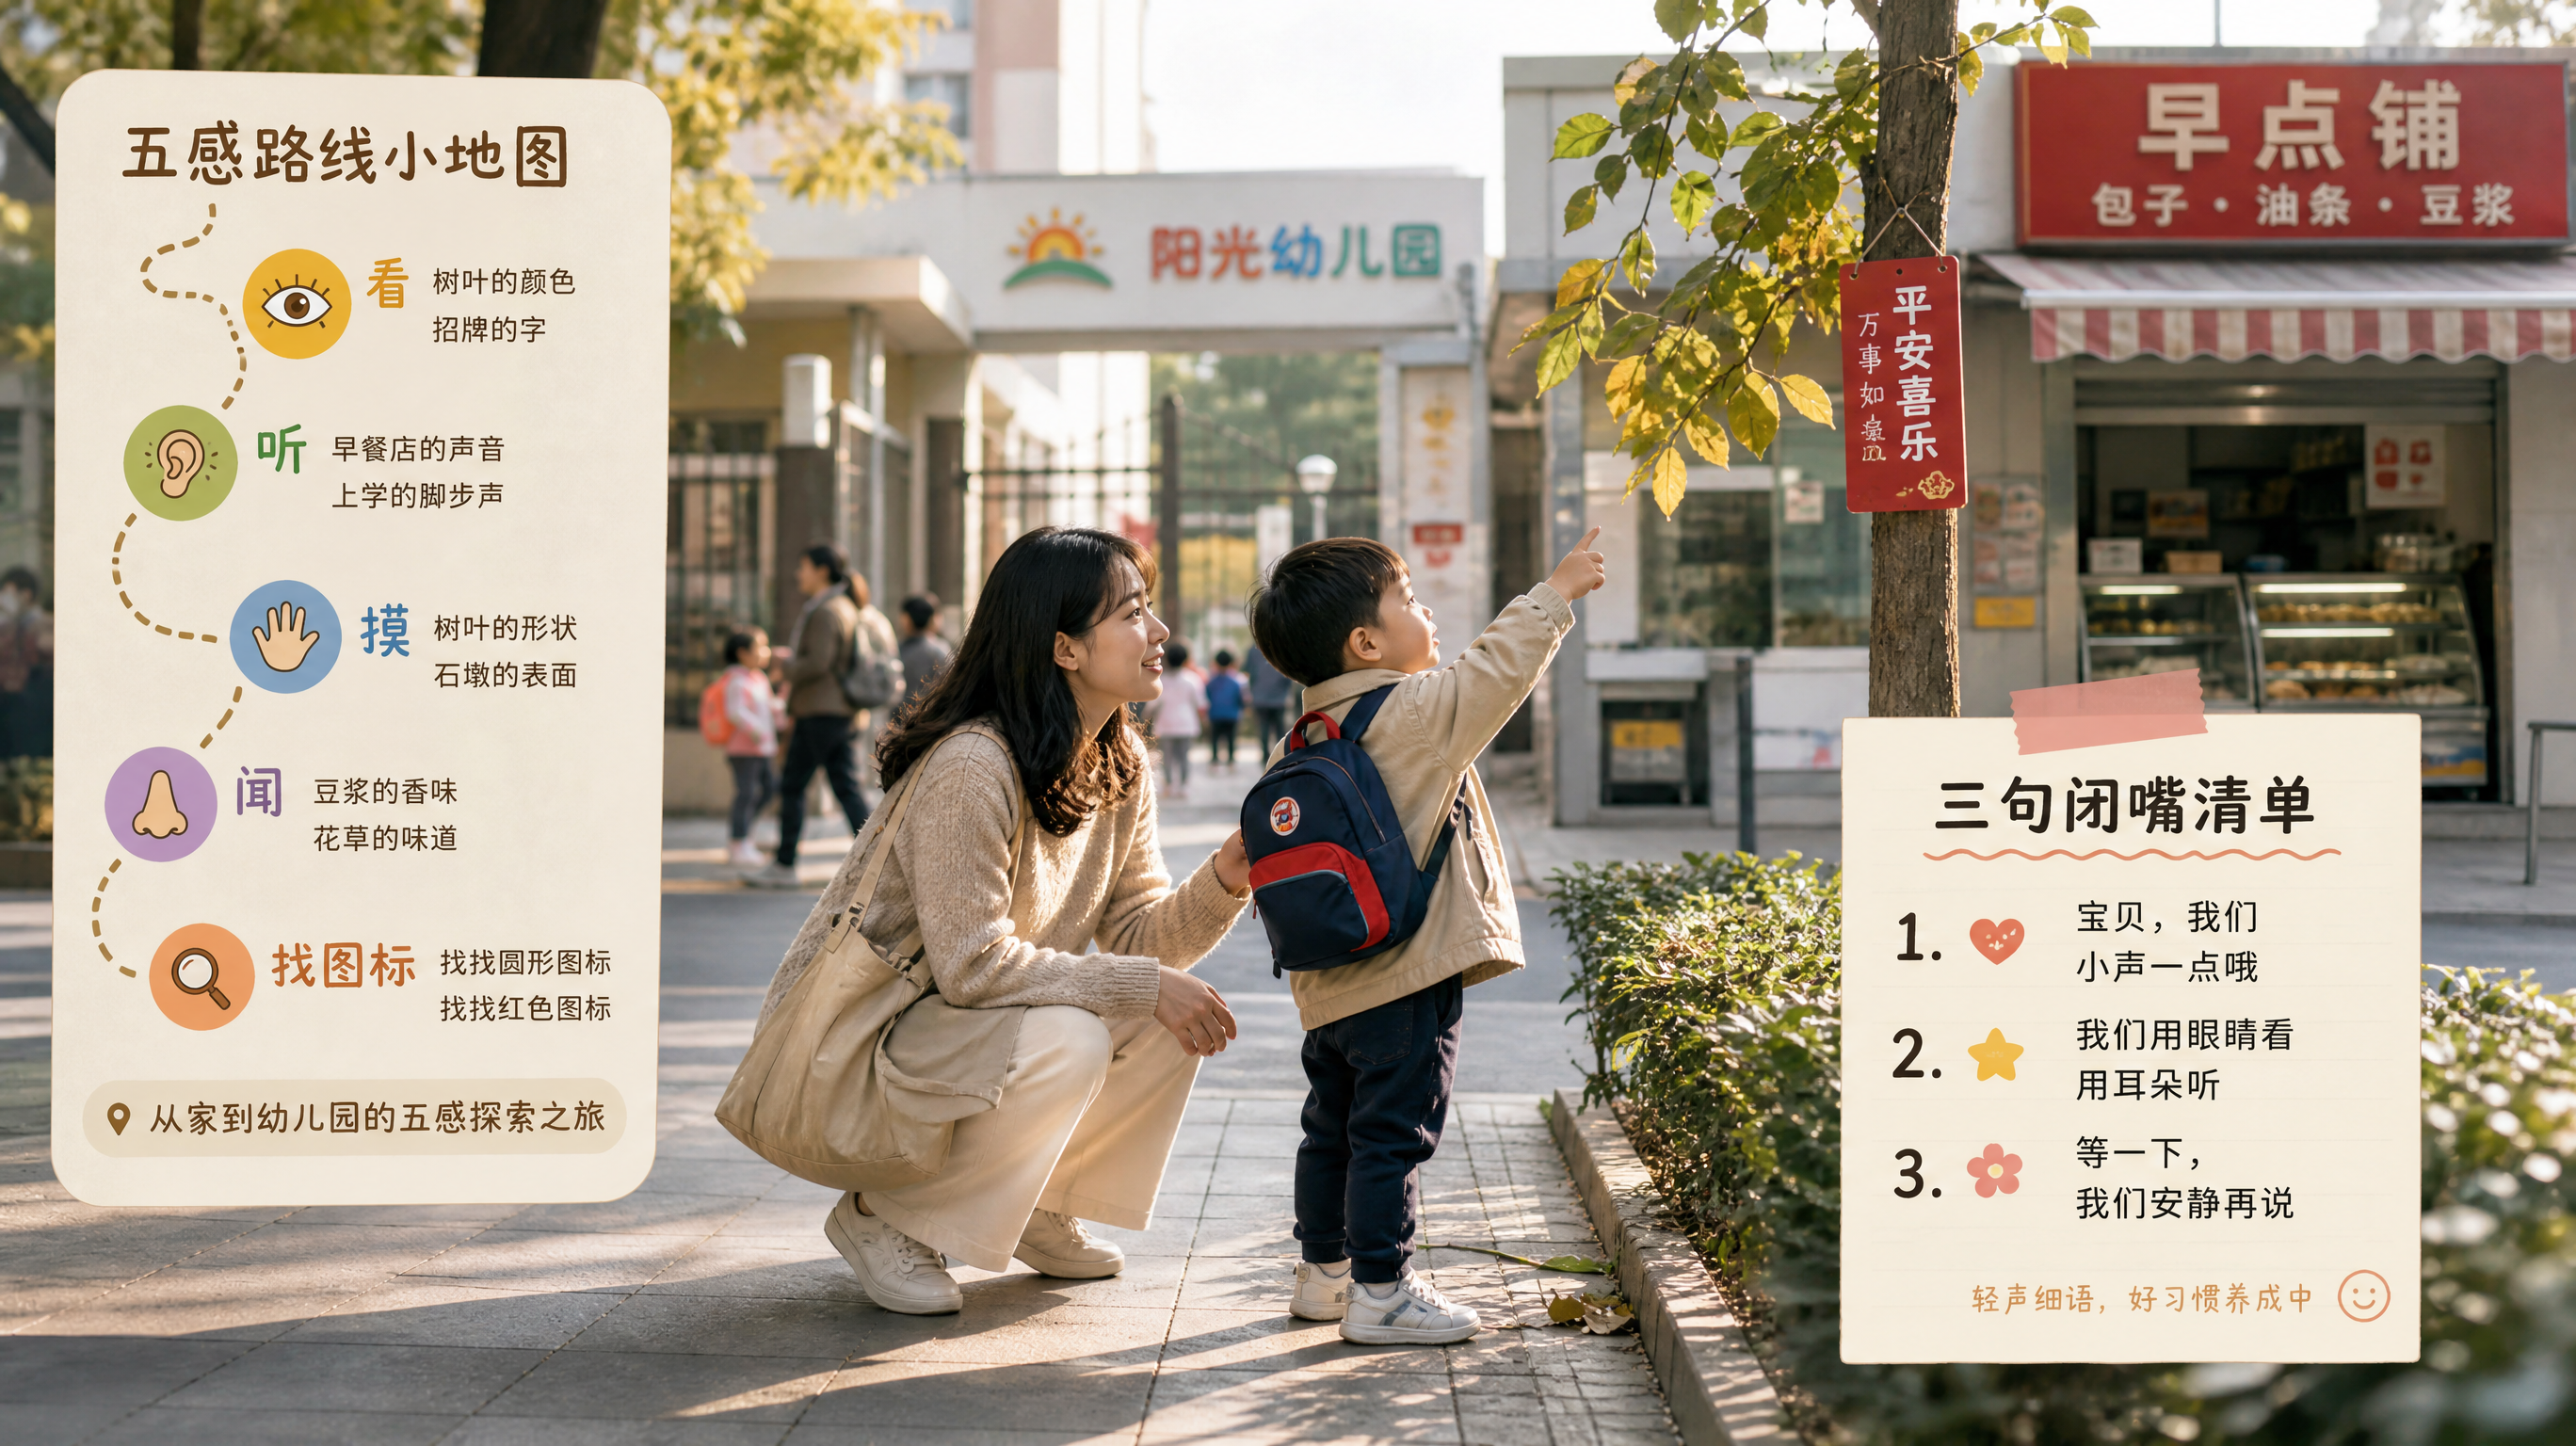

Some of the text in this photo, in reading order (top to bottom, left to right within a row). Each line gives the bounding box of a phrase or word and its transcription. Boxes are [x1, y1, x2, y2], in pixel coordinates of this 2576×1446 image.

[2138, 80, 2462, 172] 早点铺
[1150, 223, 1442, 280] 阳光幼儿园
[1892, 285, 1939, 462] 平安喜乐
